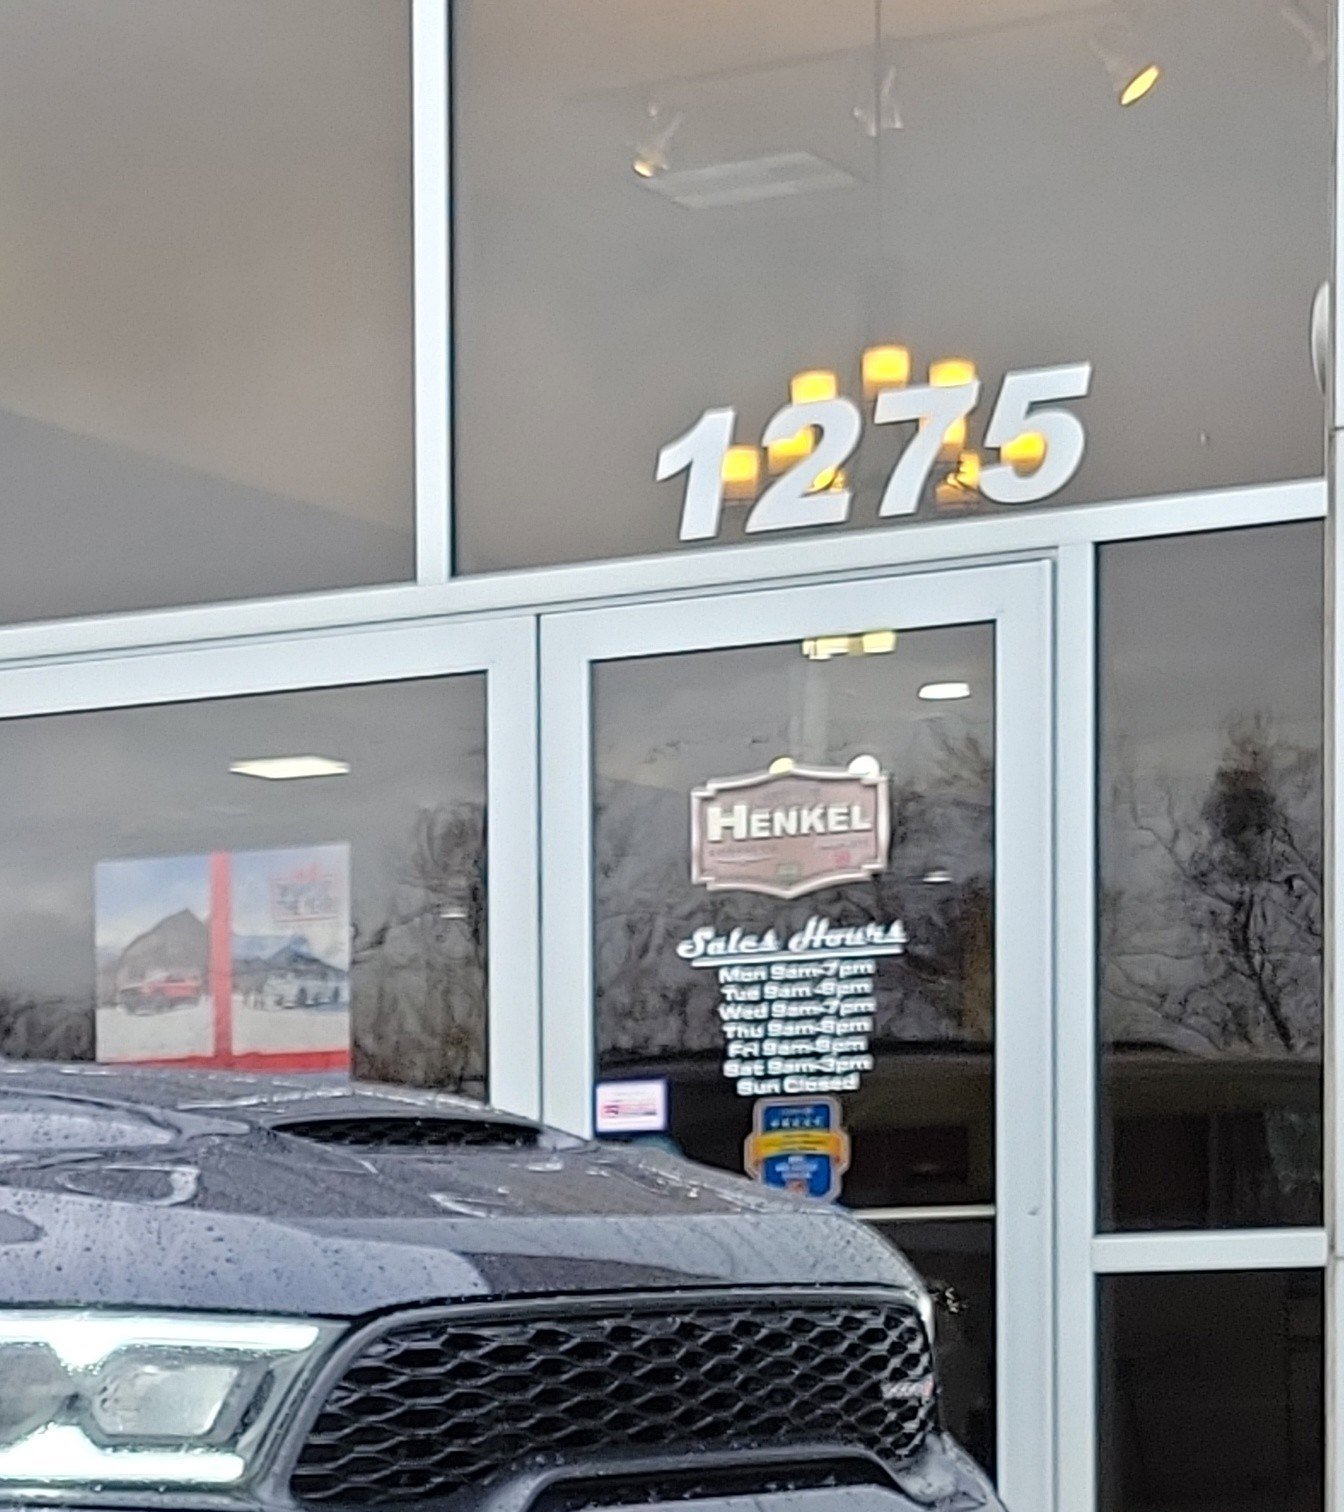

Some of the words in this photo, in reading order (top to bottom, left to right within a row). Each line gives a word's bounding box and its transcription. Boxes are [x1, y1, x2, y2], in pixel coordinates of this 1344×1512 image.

[655, 360, 1092, 541] 1275
[706, 803, 874, 842] HENKEL
[676, 926, 779, 959] Sales
[788, 914, 910, 953] Hours
[719, 966, 767, 983] Mon
[721, 985, 761, 1001] Tue
[718, 1002, 769, 1020] Wed
[722, 1022, 765, 1038] Thu
[728, 1040, 759, 1057] Fri
[723, 1060, 765, 1077] Sat
[737, 1078, 780, 1096] Sun
[784, 1072, 860, 1093] Closed
